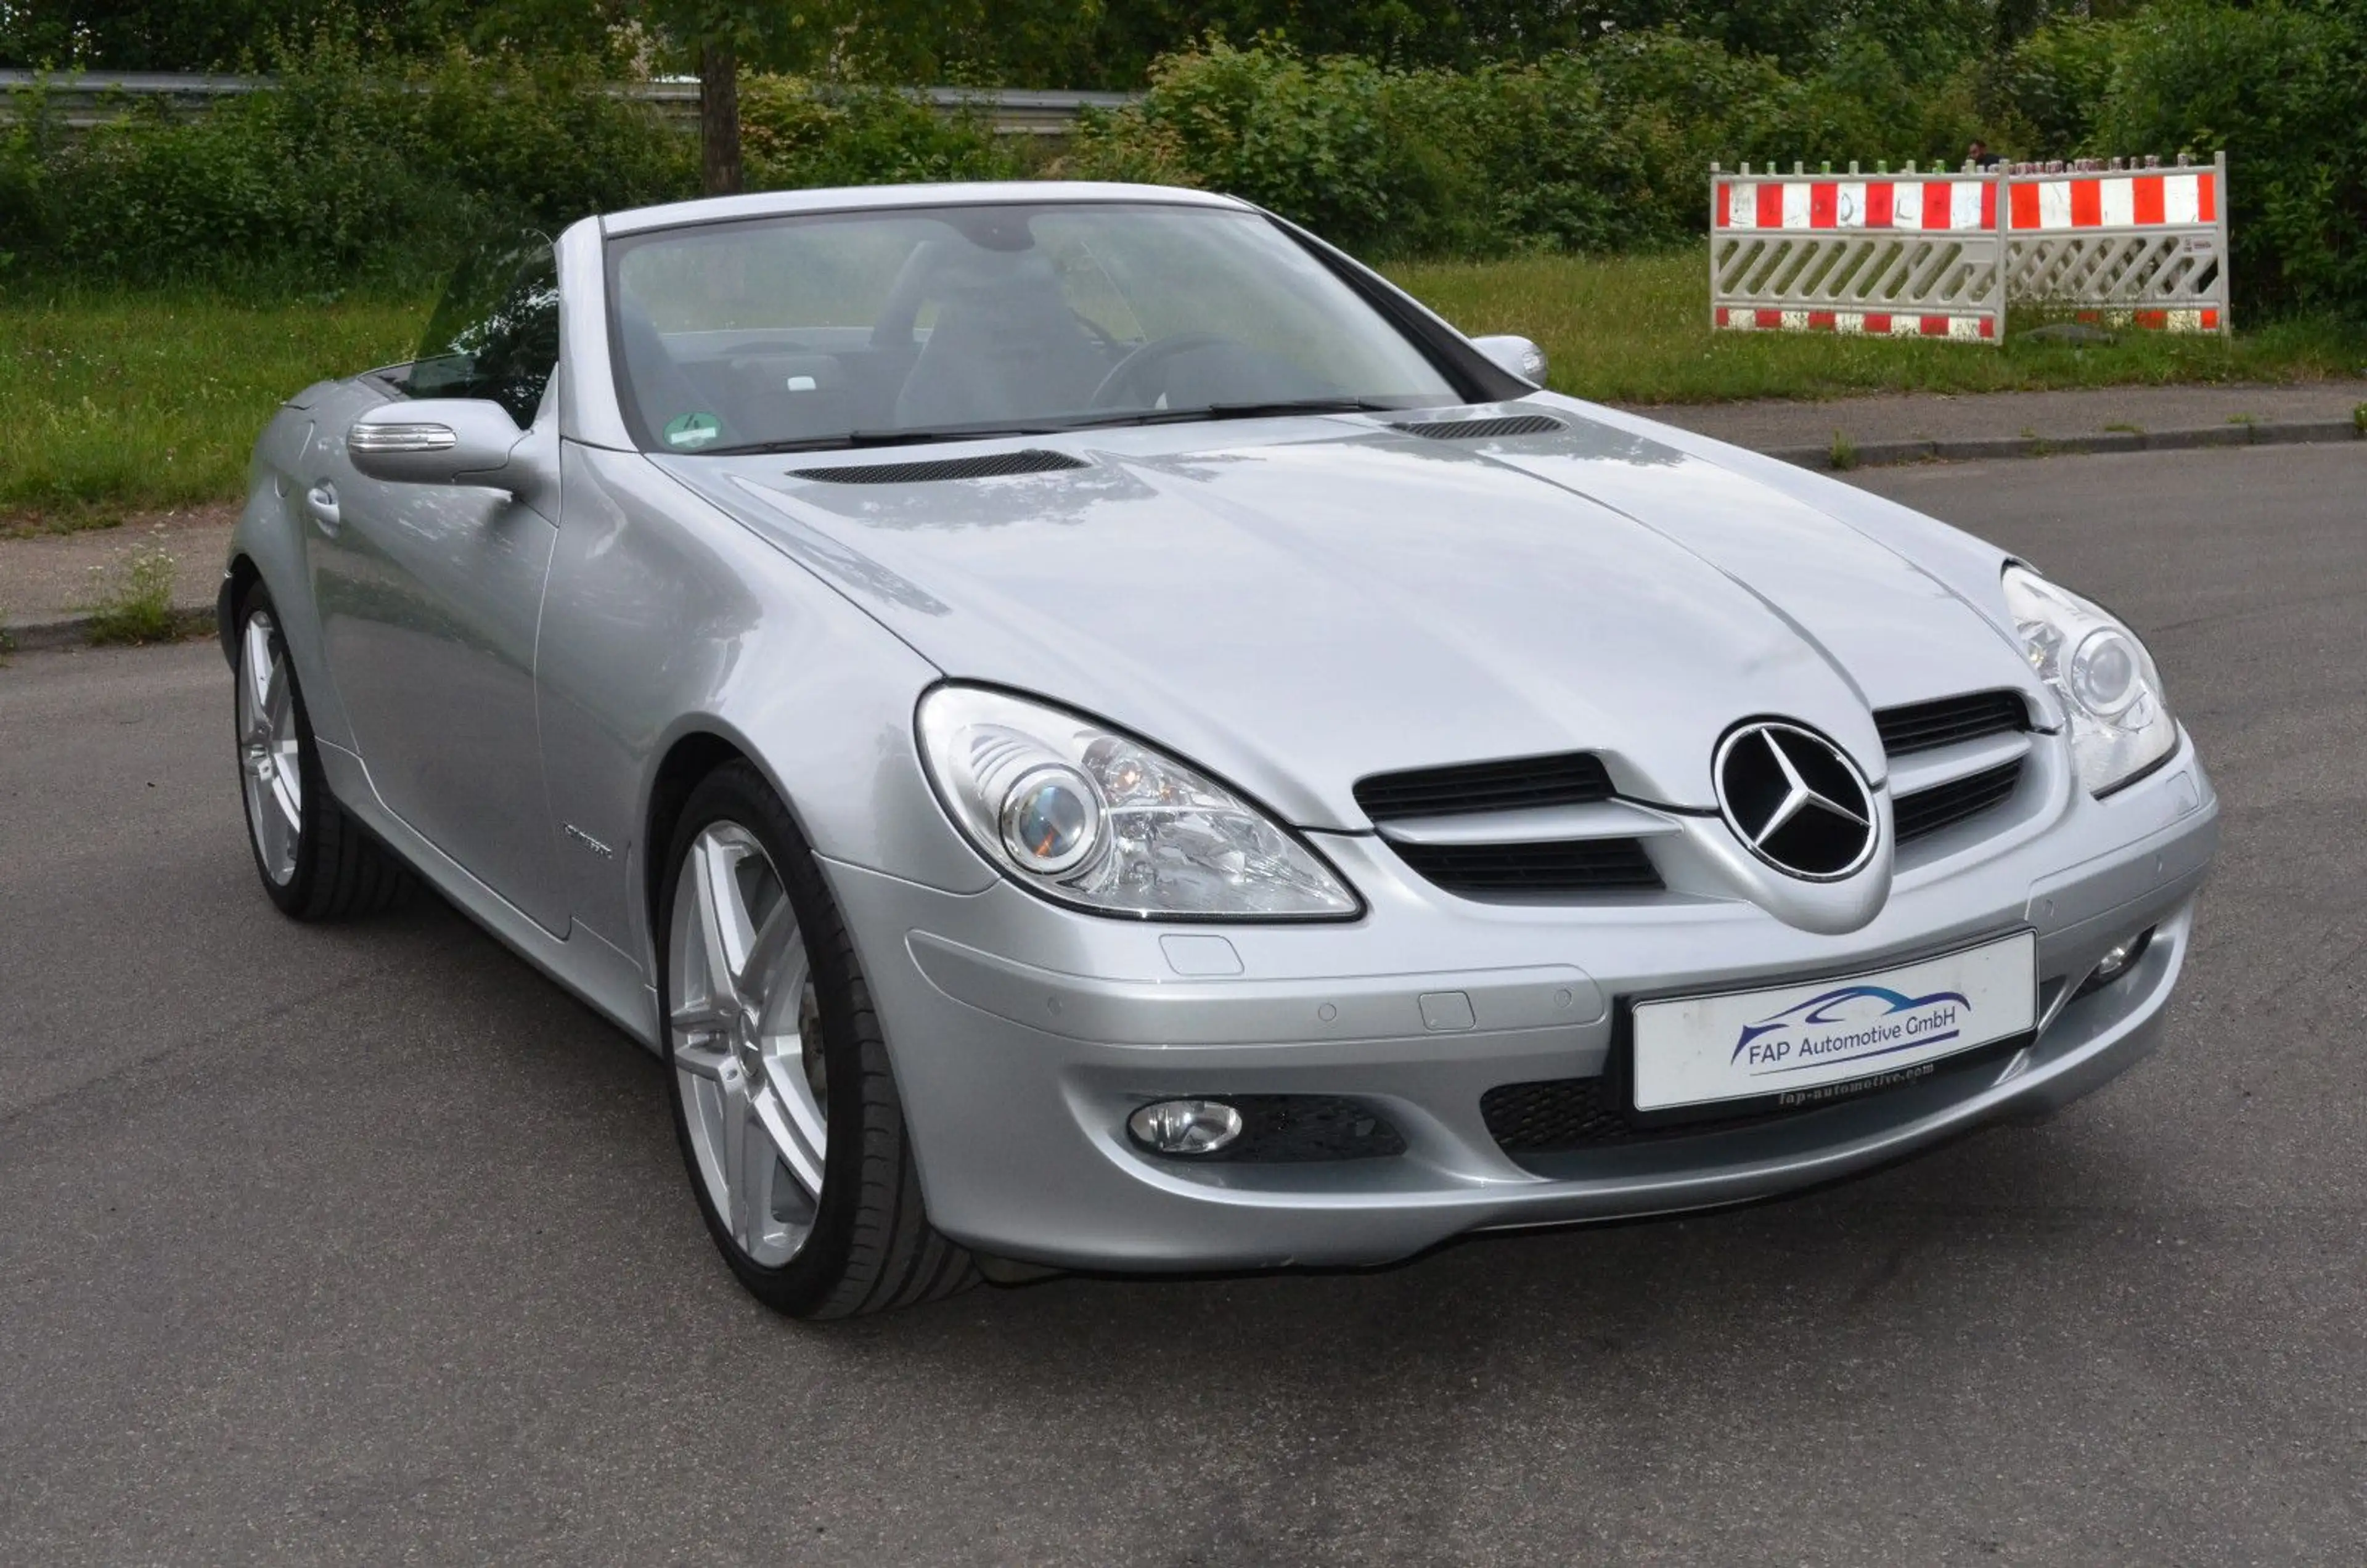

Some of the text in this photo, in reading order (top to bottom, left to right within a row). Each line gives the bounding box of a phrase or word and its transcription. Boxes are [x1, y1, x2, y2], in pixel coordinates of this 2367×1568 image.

[1749, 1006, 1955, 1064] FAP Automotive GmbH
[1779, 1063, 1934, 1105] fap-automotive.com
